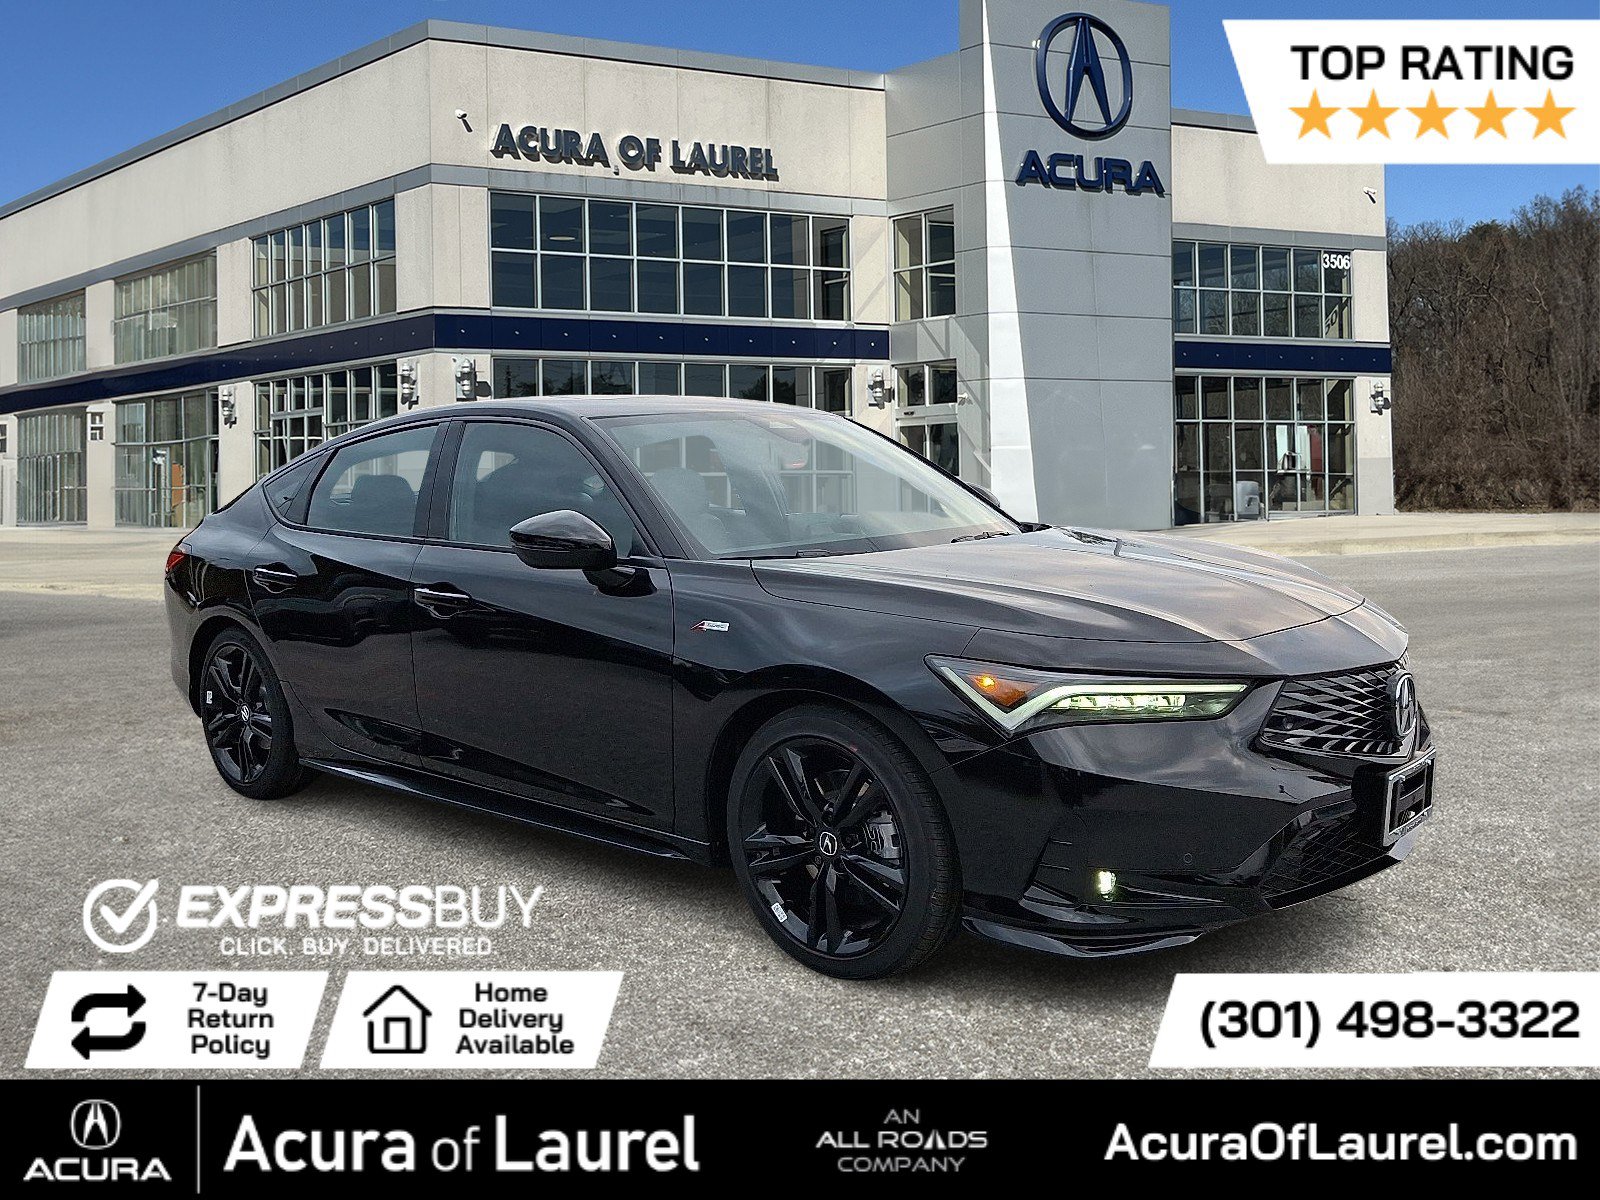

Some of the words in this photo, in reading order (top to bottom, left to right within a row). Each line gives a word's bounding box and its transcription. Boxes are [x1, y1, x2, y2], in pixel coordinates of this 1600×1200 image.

[491, 123, 611, 168] ACURA
[617, 135, 662, 171] OF
[669, 140, 779, 182] LAUREL
[1015, 150, 1165, 198] ACURA
[1322, 253, 1351, 270] 3506
